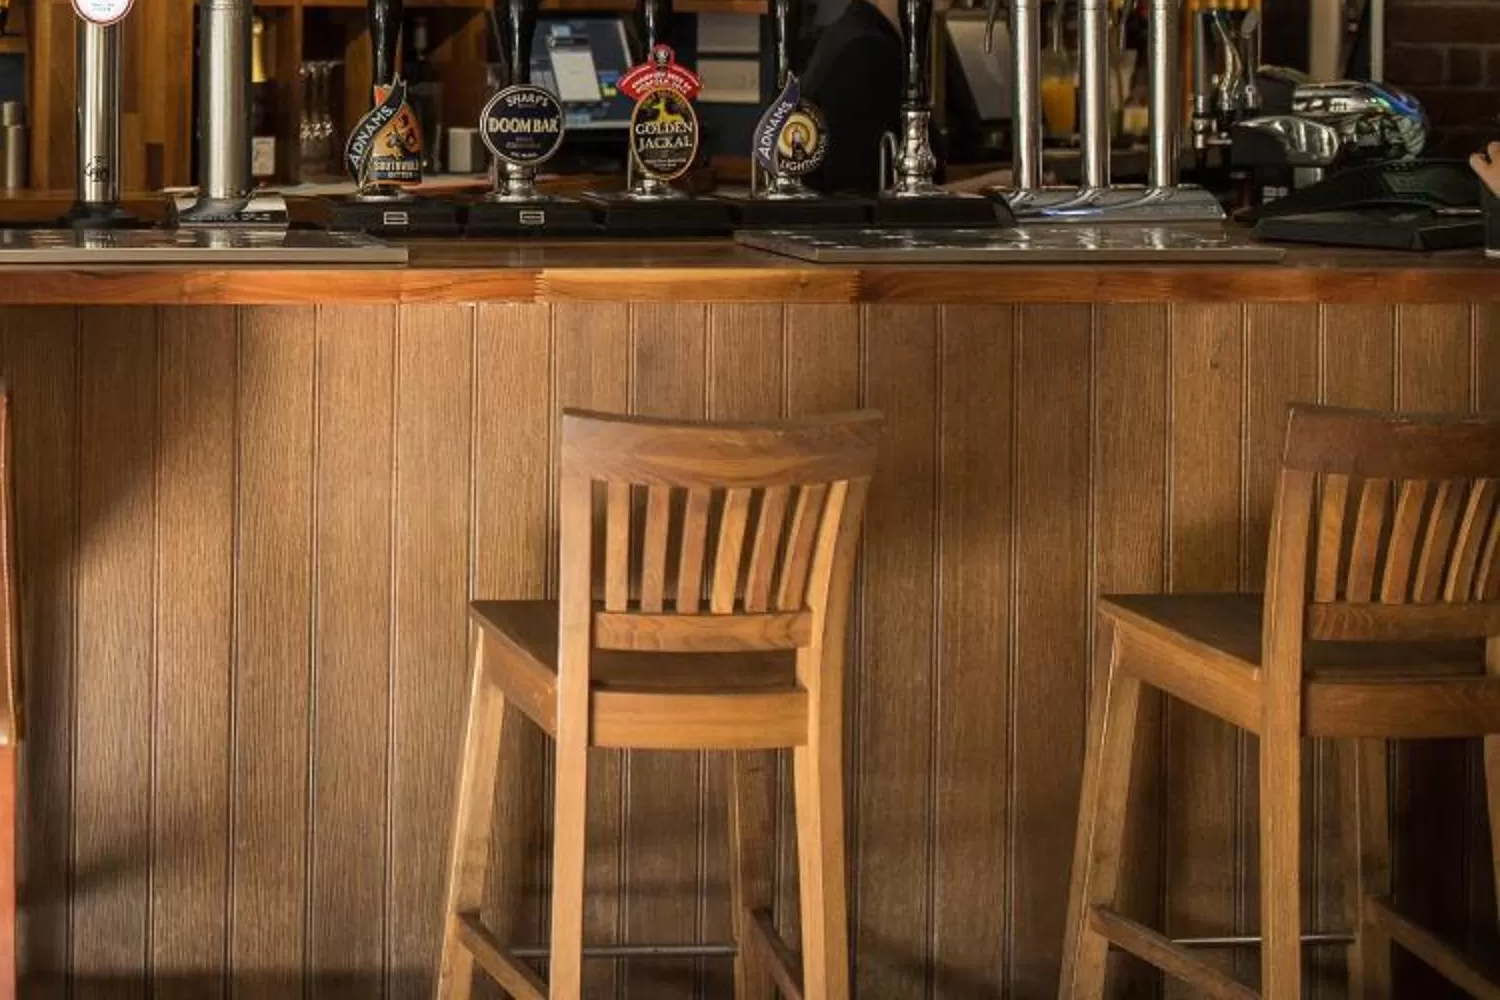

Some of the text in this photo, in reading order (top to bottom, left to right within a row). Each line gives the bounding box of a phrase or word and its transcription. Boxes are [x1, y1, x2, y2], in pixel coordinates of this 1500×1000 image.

[488, 117, 558, 133] DOOM BAR
[636, 121, 693, 135] GOLDEN
[758, 101, 793, 160] ADNAMS
[349, 105, 397, 169] ADNAMS
[638, 135, 693, 152] JACKAL
